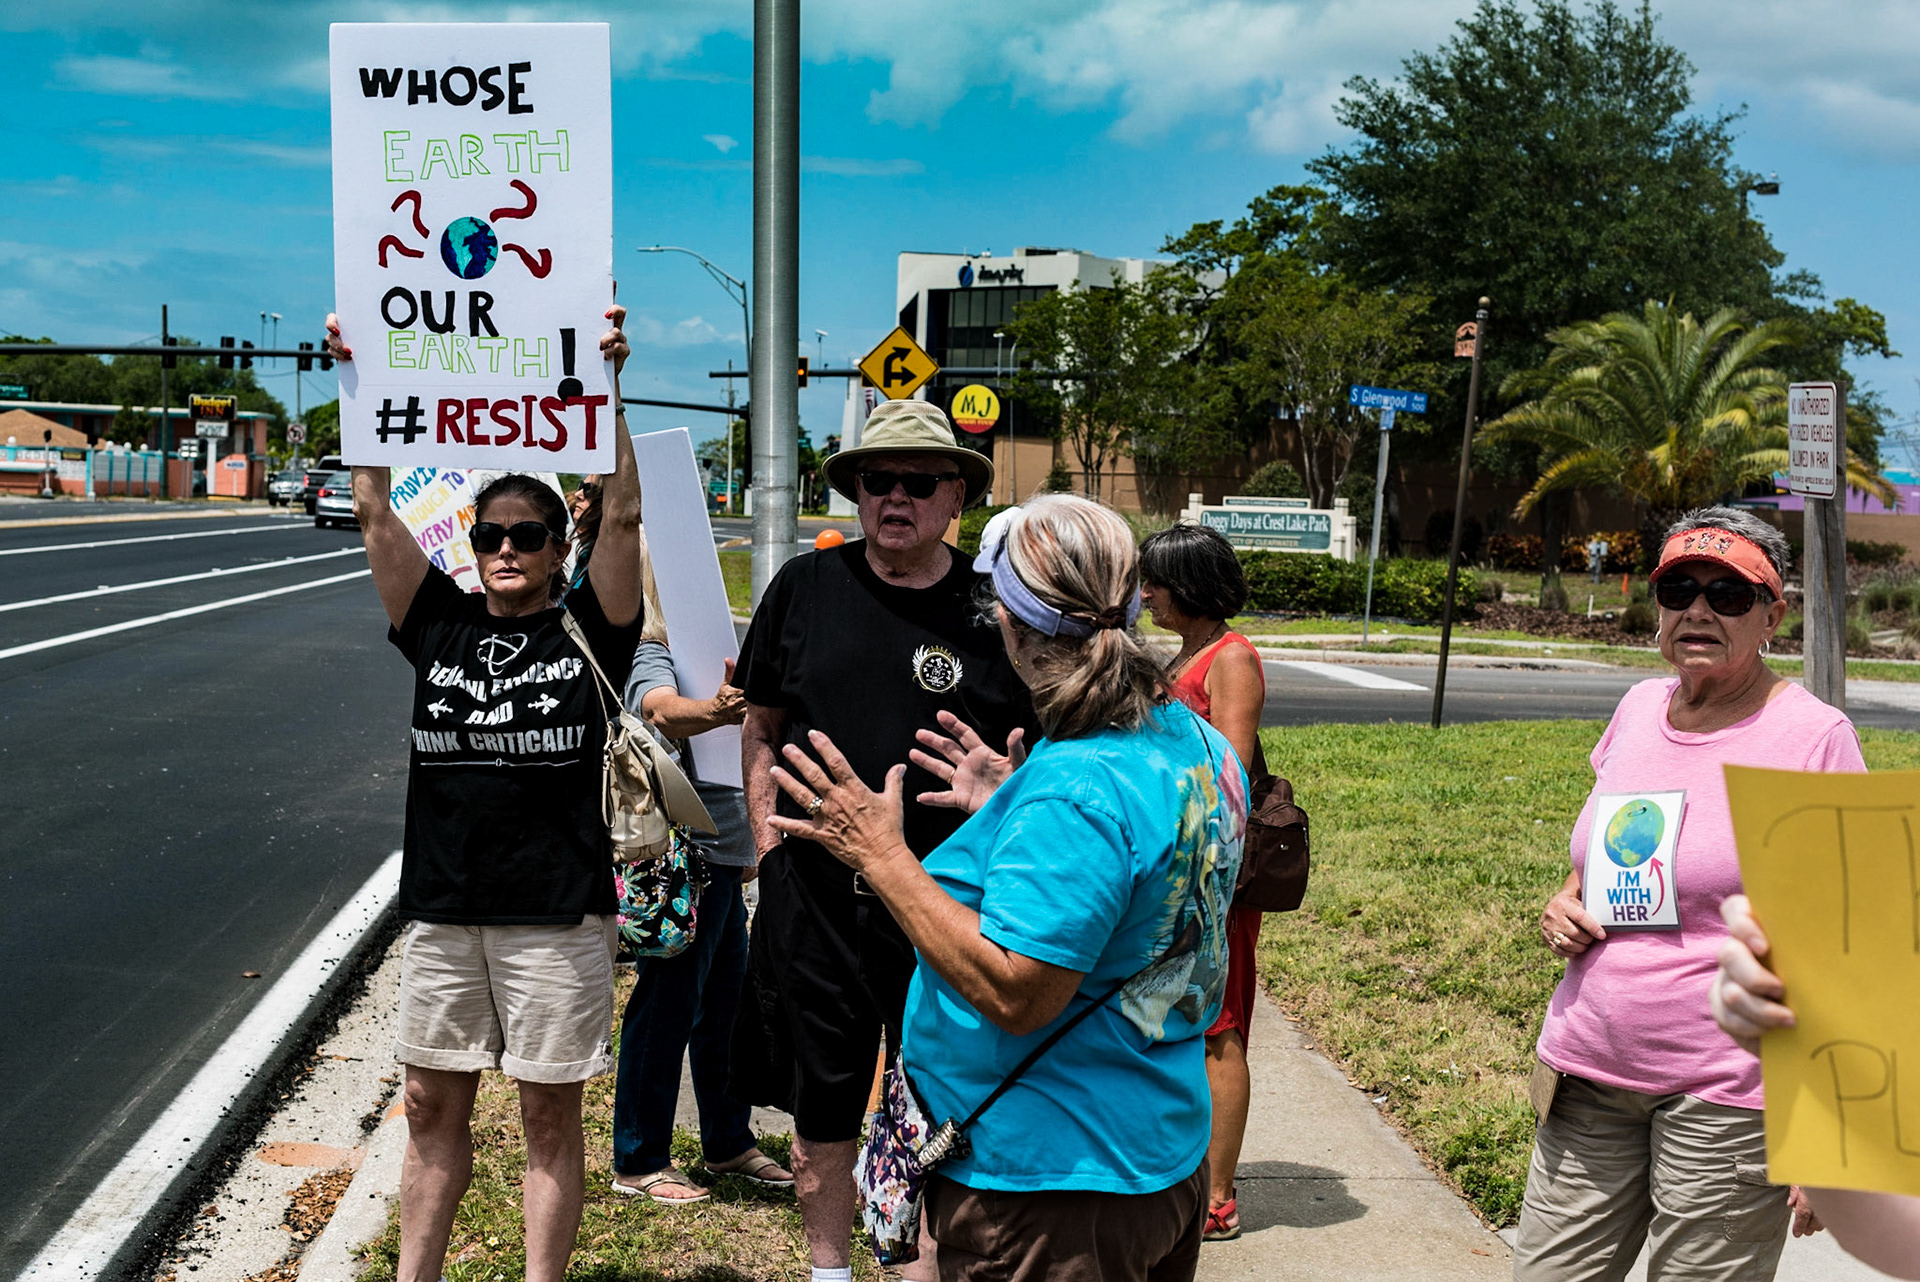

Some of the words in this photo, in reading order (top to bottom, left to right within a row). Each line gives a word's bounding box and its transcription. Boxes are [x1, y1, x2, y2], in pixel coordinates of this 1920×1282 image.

[359, 61, 533, 114] WHOSE
[383, 129, 570, 182] EARTH
[380, 286, 499, 337] OUR
[193, 395, 232, 407] Budget
[1351, 388, 1358, 402] S
[1362, 389, 1407, 408] Glenwood
[1412, 403, 1425, 411] 500
[200, 406, 224, 416] INN
[376, 395, 608, 452] #RESIST
[1811, 424, 1833, 442] VEHICLES
[1810, 451, 1815, 468] IN
[1816, 451, 1830, 469] PARK
[401, 485, 450, 528] NOUGH
[441, 471, 465, 491] TO
[416, 516, 453, 551] VERY
[456, 504, 477, 531] MA
[1202, 512, 1228, 534] Doggy
[1231, 513, 1252, 533] Days
[1253, 517, 1262, 530] at
[1262, 514, 1285, 531] Crest
[1286, 515, 1307, 532] Lake
[1308, 516, 1329, 532] Park
[1245, 538, 1254, 546] OF
[1255, 539, 1299, 547] CLEARWATER
[430, 548, 448, 571] OT
[464, 701, 514, 726] AND
[468, 725, 586, 755] CRITICALLY
[1617, 871, 1640, 887] I'M
[1607, 888, 1651, 905] WITH
[1613, 905, 1649, 921] HER
